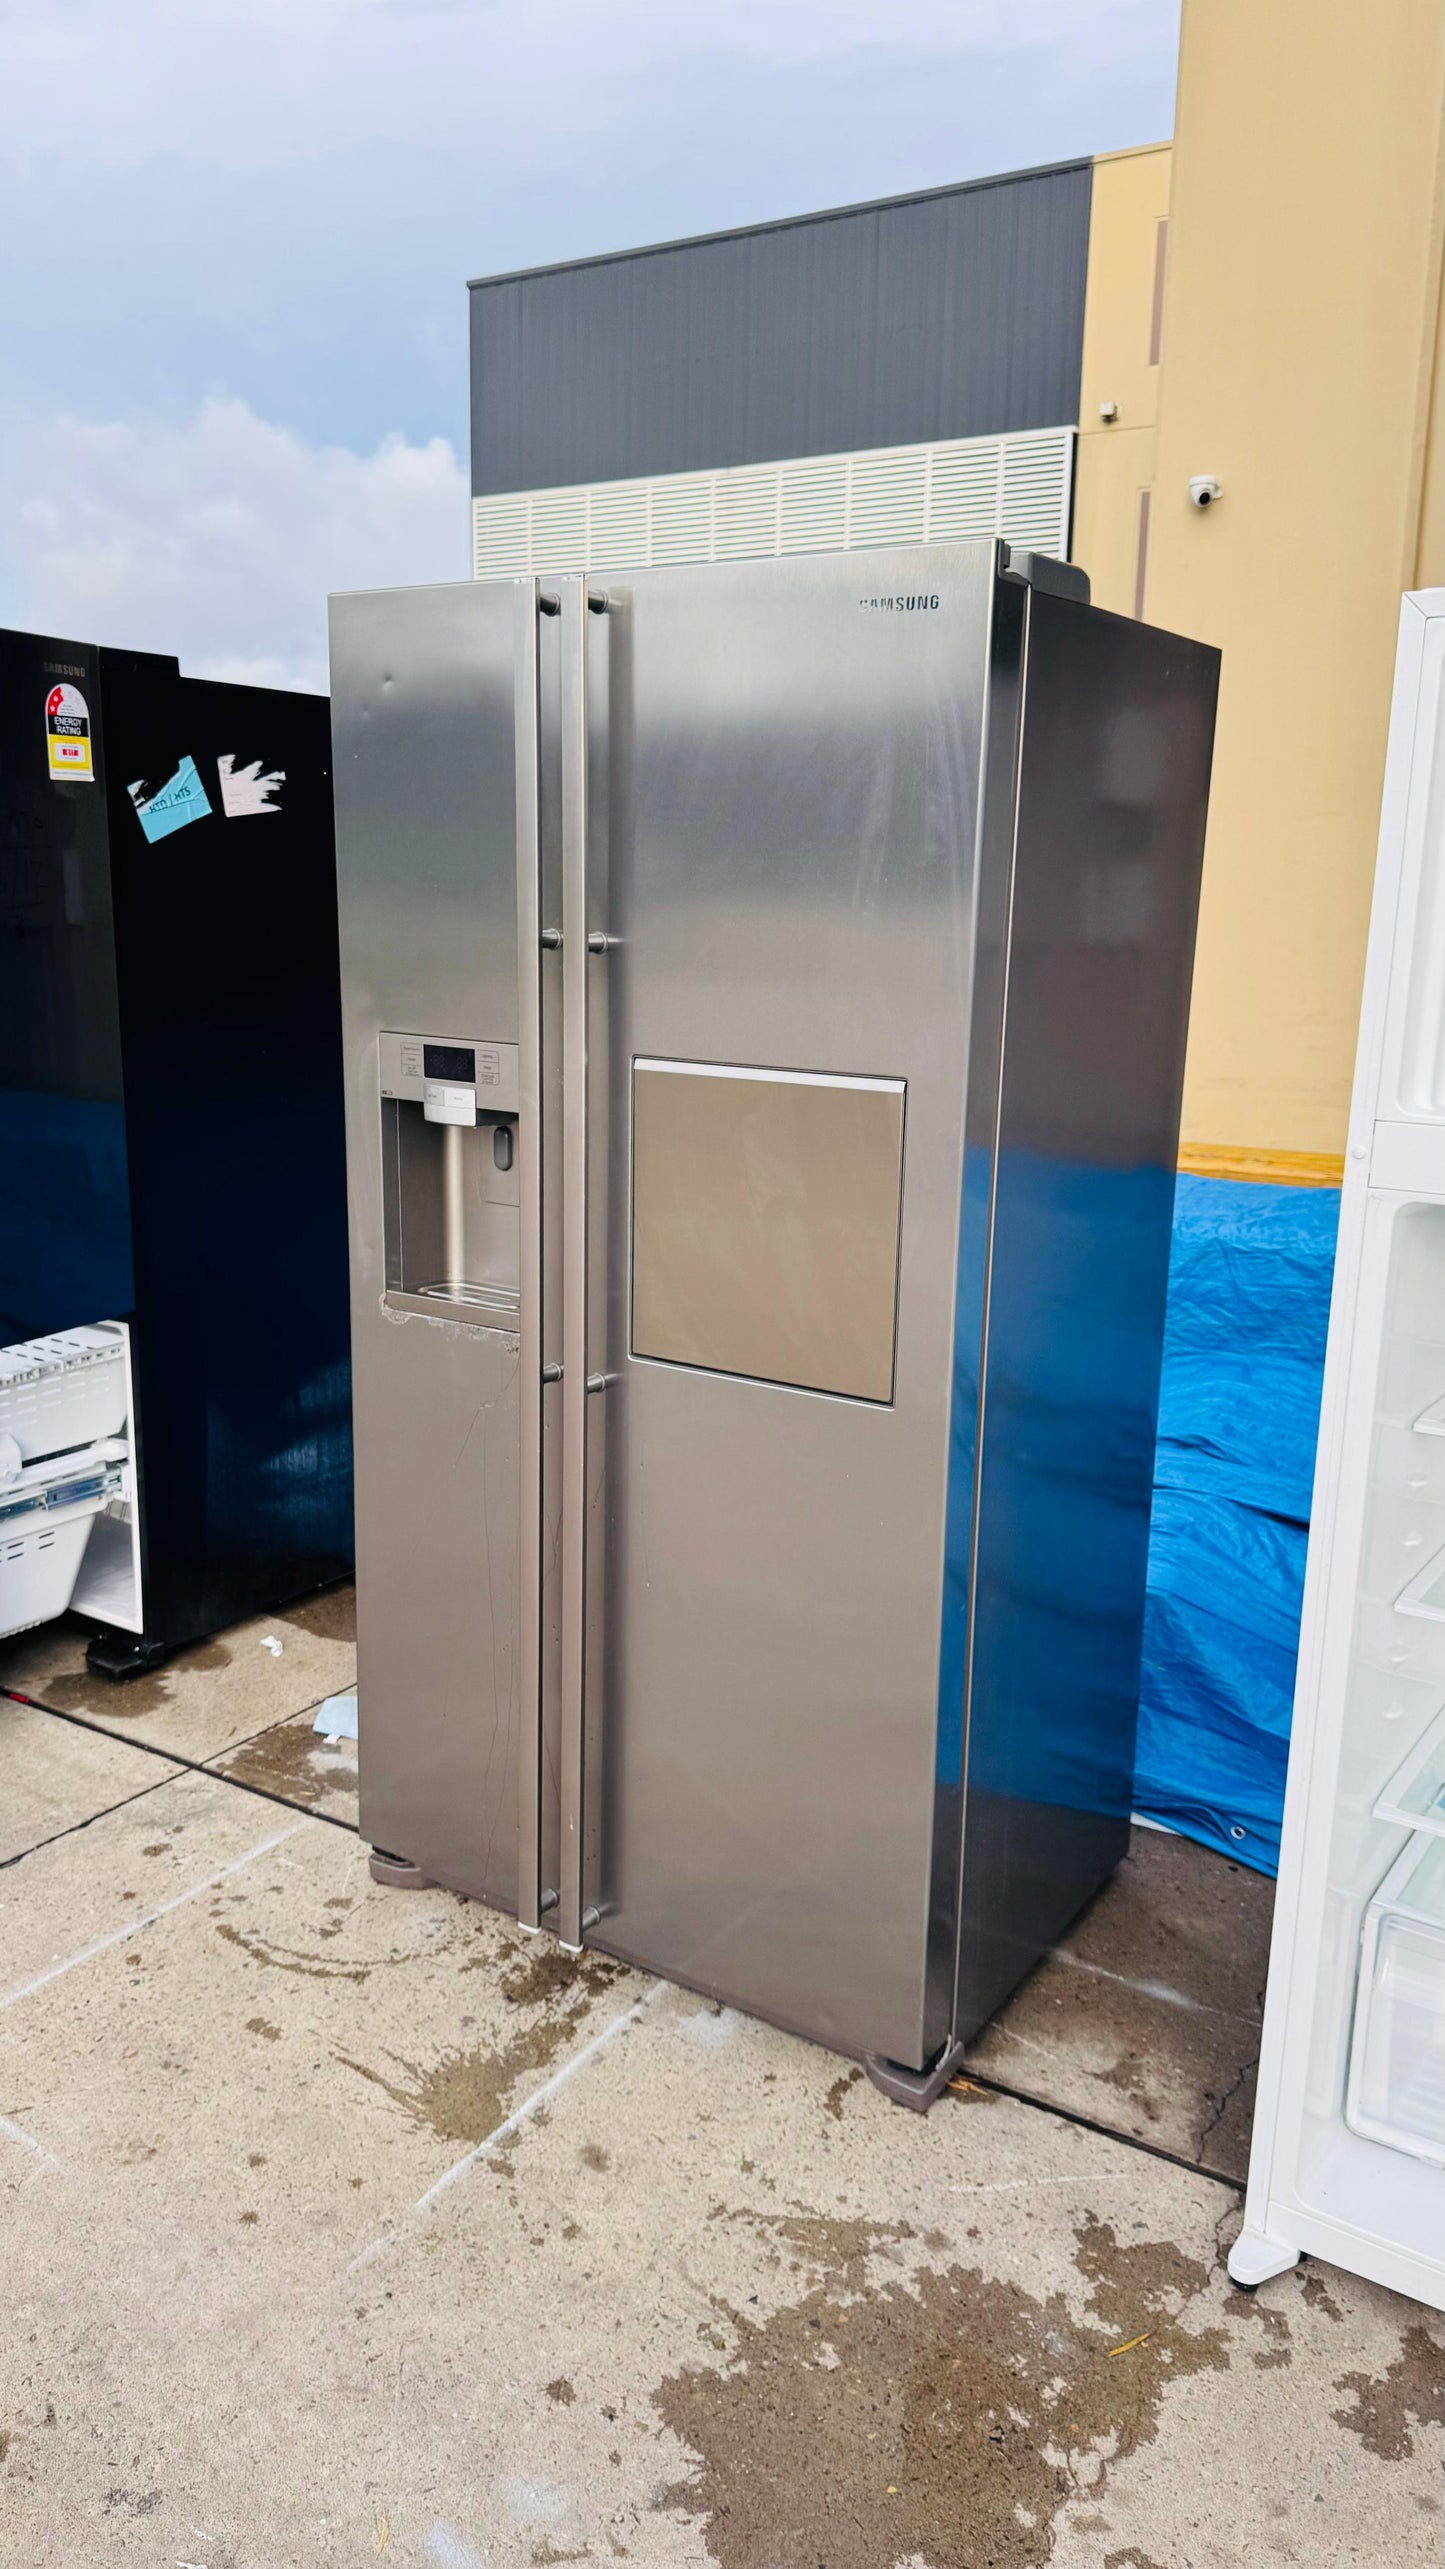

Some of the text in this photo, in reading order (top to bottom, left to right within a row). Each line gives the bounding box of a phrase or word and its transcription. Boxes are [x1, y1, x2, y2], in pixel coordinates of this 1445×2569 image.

[858, 594, 940, 612] SAMSUNG
[54, 716, 83, 727] ENERGY
[56, 726, 82, 736] RATING
